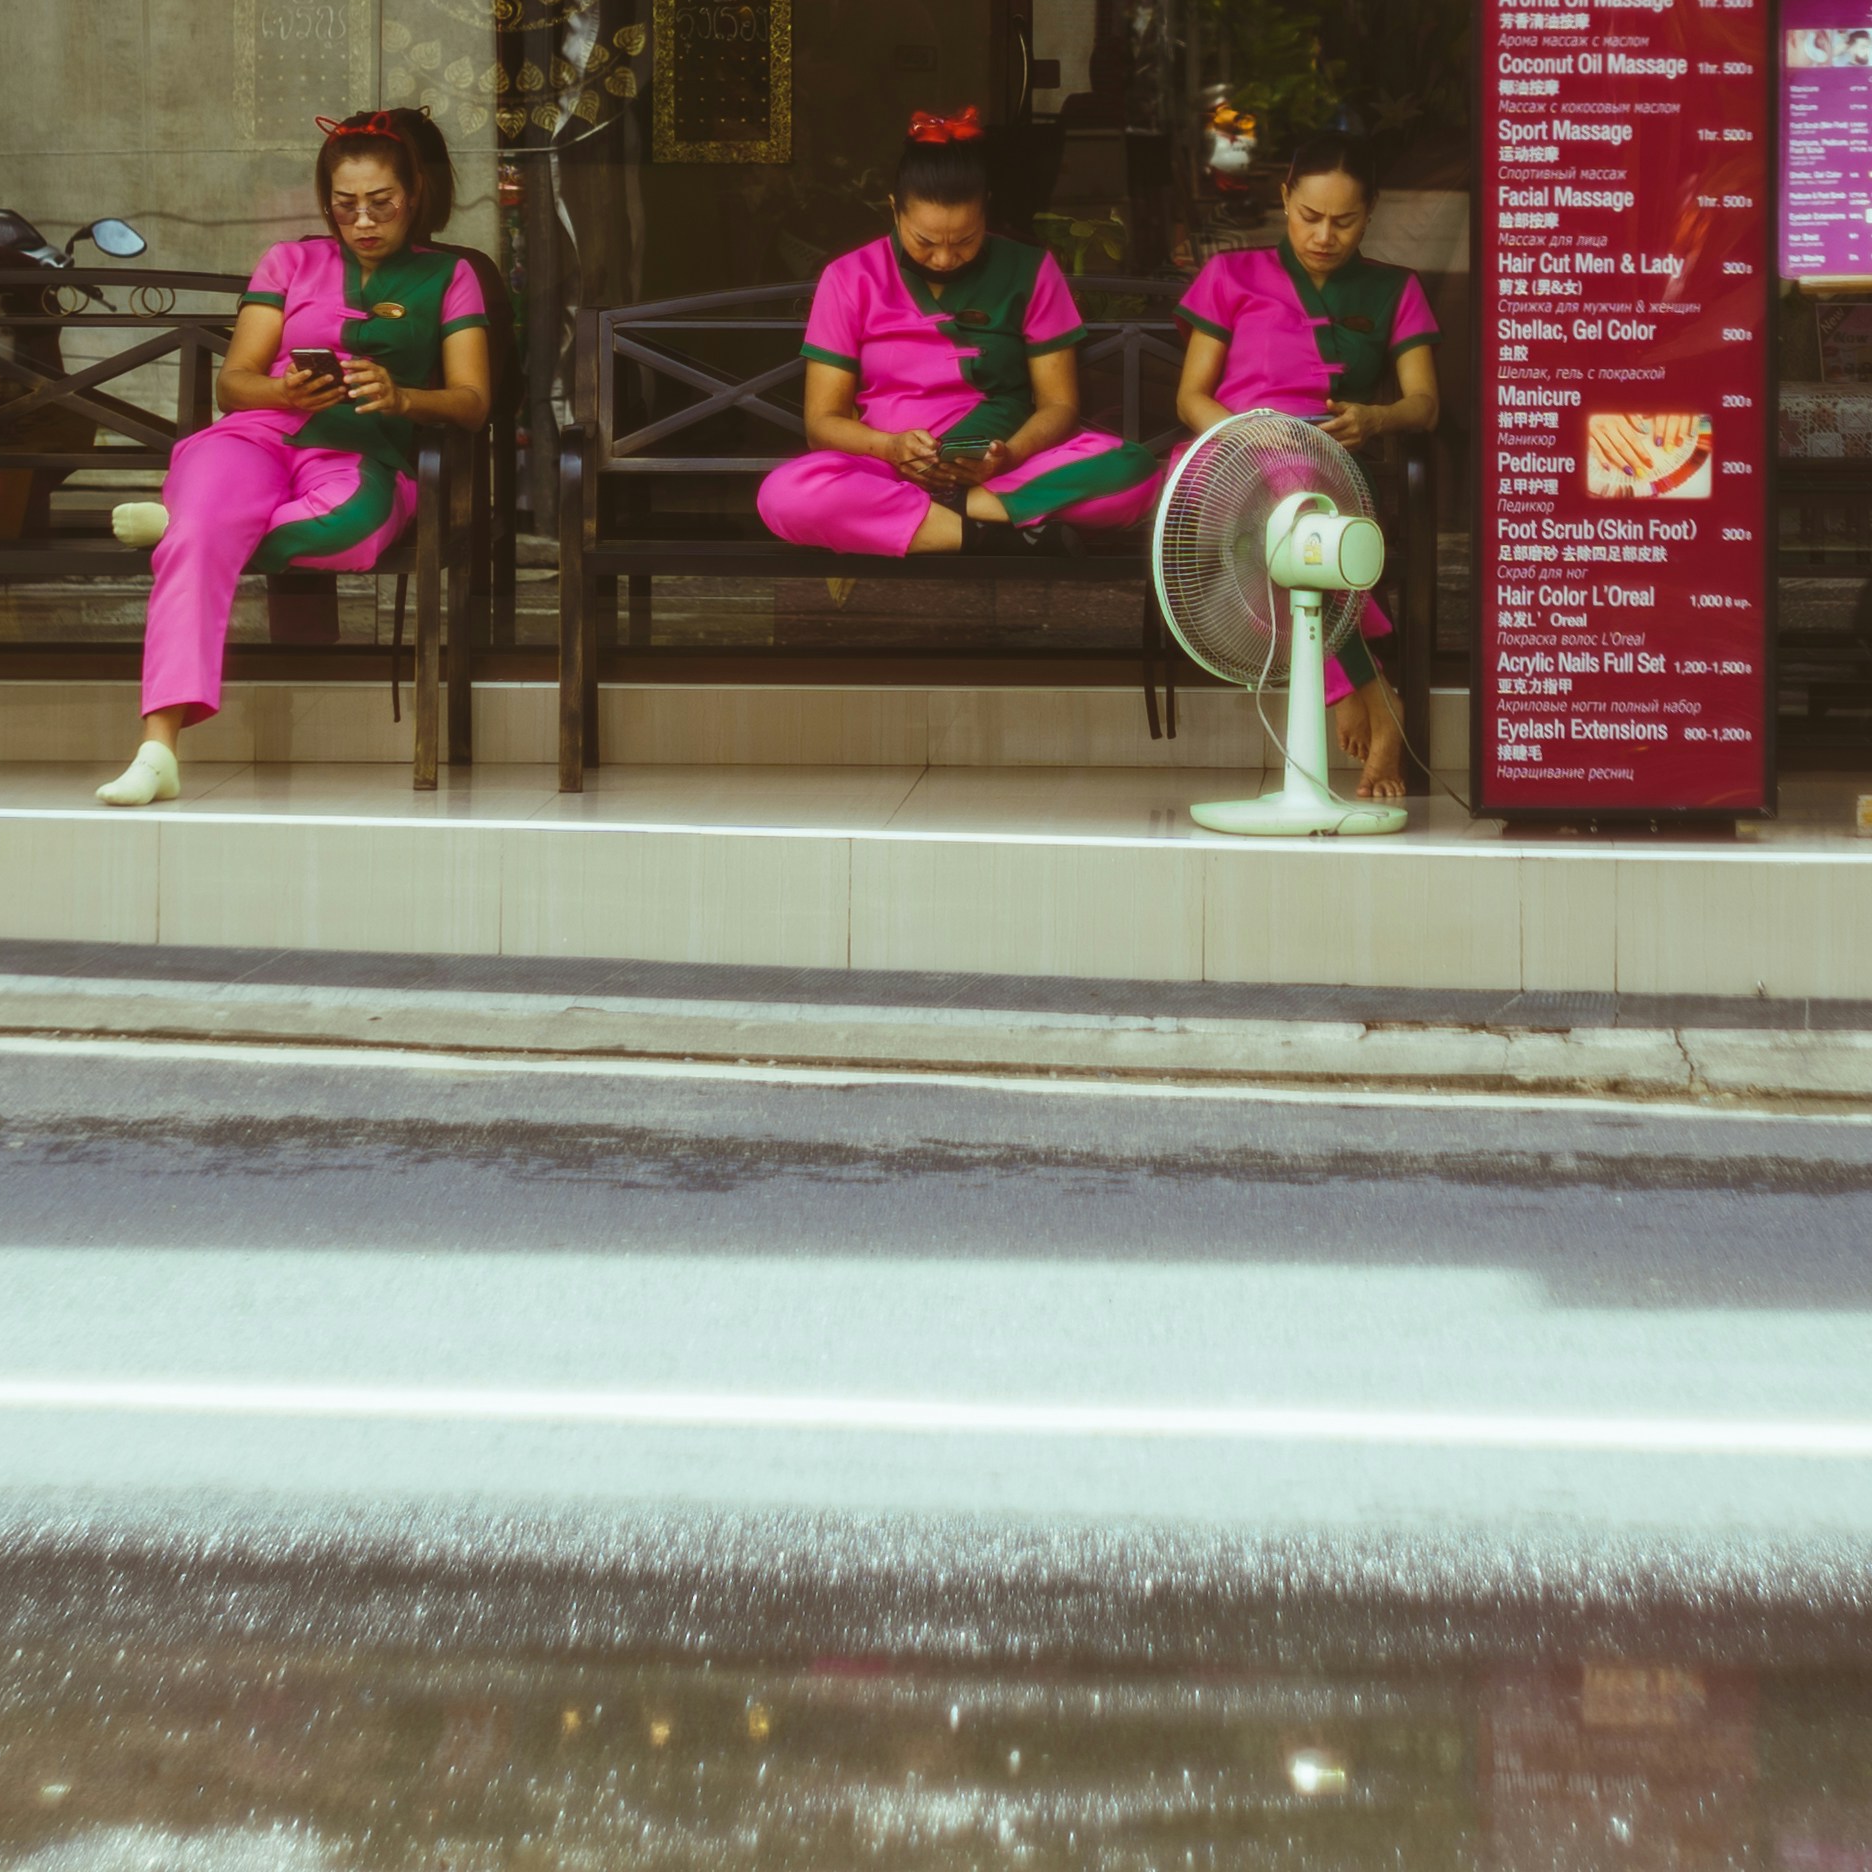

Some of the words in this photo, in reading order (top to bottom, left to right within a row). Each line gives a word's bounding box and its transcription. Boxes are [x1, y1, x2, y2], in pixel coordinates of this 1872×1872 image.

[1498, 53, 1573, 74] Coconut
[1578, 53, 1602, 74] Oil
[1607, 53, 1687, 79] Massage
[1498, 120, 1548, 145] Sport
[1553, 120, 1633, 146] Massage
[1498, 186, 1549, 207] Facial
[1554, 186, 1634, 212] Massage
[1498, 253, 1536, 273] Hair
[1539, 253, 1571, 273] Cut
[1575, 253, 1614, 273] Men
[1620, 253, 1635, 273] &
[1641, 253, 1684, 279] Lady
[1498, 319, 1568, 342] Shellac,
[1573, 319, 1602, 340] Gel
[1607, 319, 1656, 340] Color
[1497, 386, 1581, 407] Manicure
[1497, 433, 1556, 447] Маникюр
[1497, 452, 1575, 473] Pedicure
[1497, 499, 1554, 514] Педикюр
[1497, 518, 1537, 540] Foot
[1542, 518, 1595, 540] Scrub
[1598, 518, 1644, 542] (Skin
[1648, 518, 1698, 541] Foot)
[1497, 566, 1536, 579] Скраб
[1497, 585, 1534, 606] Hair
[1538, 585, 1588, 606] Color
[1497, 632, 1557, 648] Покраска
[1561, 635, 1598, 646] волос
[1497, 652, 1554, 677] Acrylic
[1558, 652, 1599, 674] Nails
[1604, 652, 1633, 674] Full
[1637, 652, 1666, 674] Set
[1497, 699, 1567, 715] Акриловые
[1571, 701, 1606, 713] ногти
[1610, 699, 1659, 713] полный
[1663, 699, 1702, 715] набор
[1497, 718, 1566, 743] Eyelash
[1571, 718, 1668, 741] Extensions
[1497, 765, 1584, 781] Наращивание
[1588, 768, 1634, 781] ресниц
